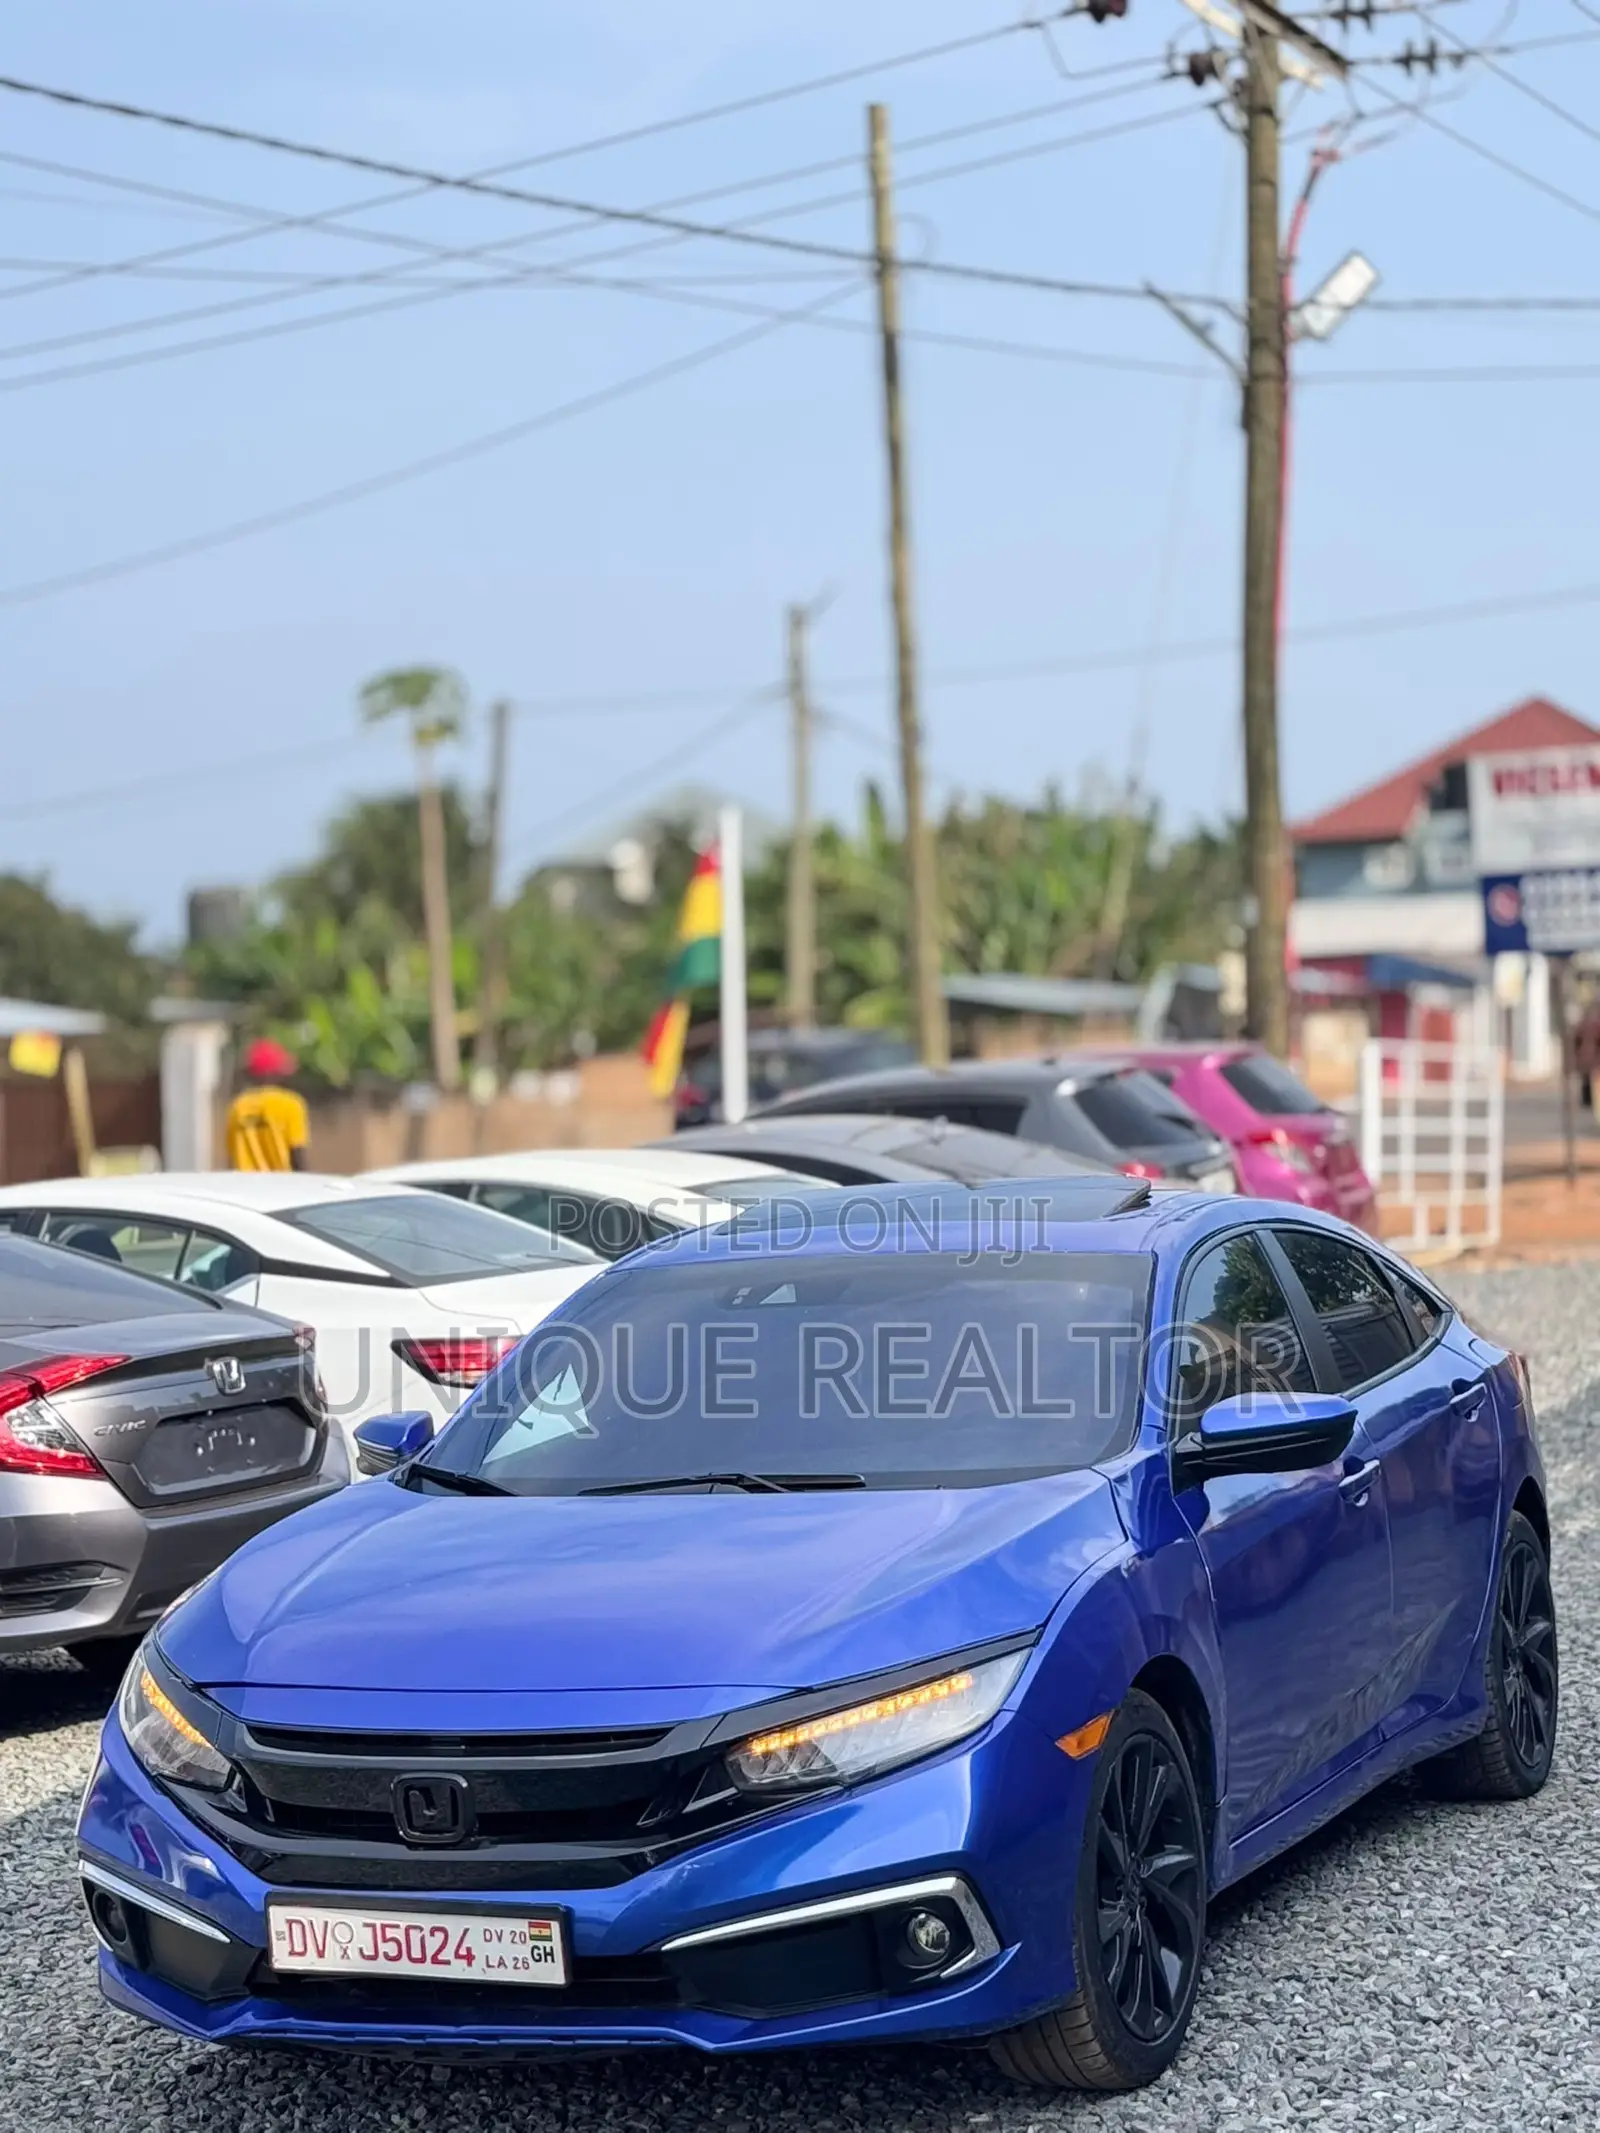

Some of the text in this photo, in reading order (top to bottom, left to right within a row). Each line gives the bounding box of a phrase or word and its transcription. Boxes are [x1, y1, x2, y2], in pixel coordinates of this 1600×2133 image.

[285, 1918, 329, 1959] DV
[358, 1922, 476, 1967] J5024
[483, 1927, 528, 1945] DV 20
[485, 1954, 531, 1970] LA 26
[530, 1944, 556, 1964] GH
